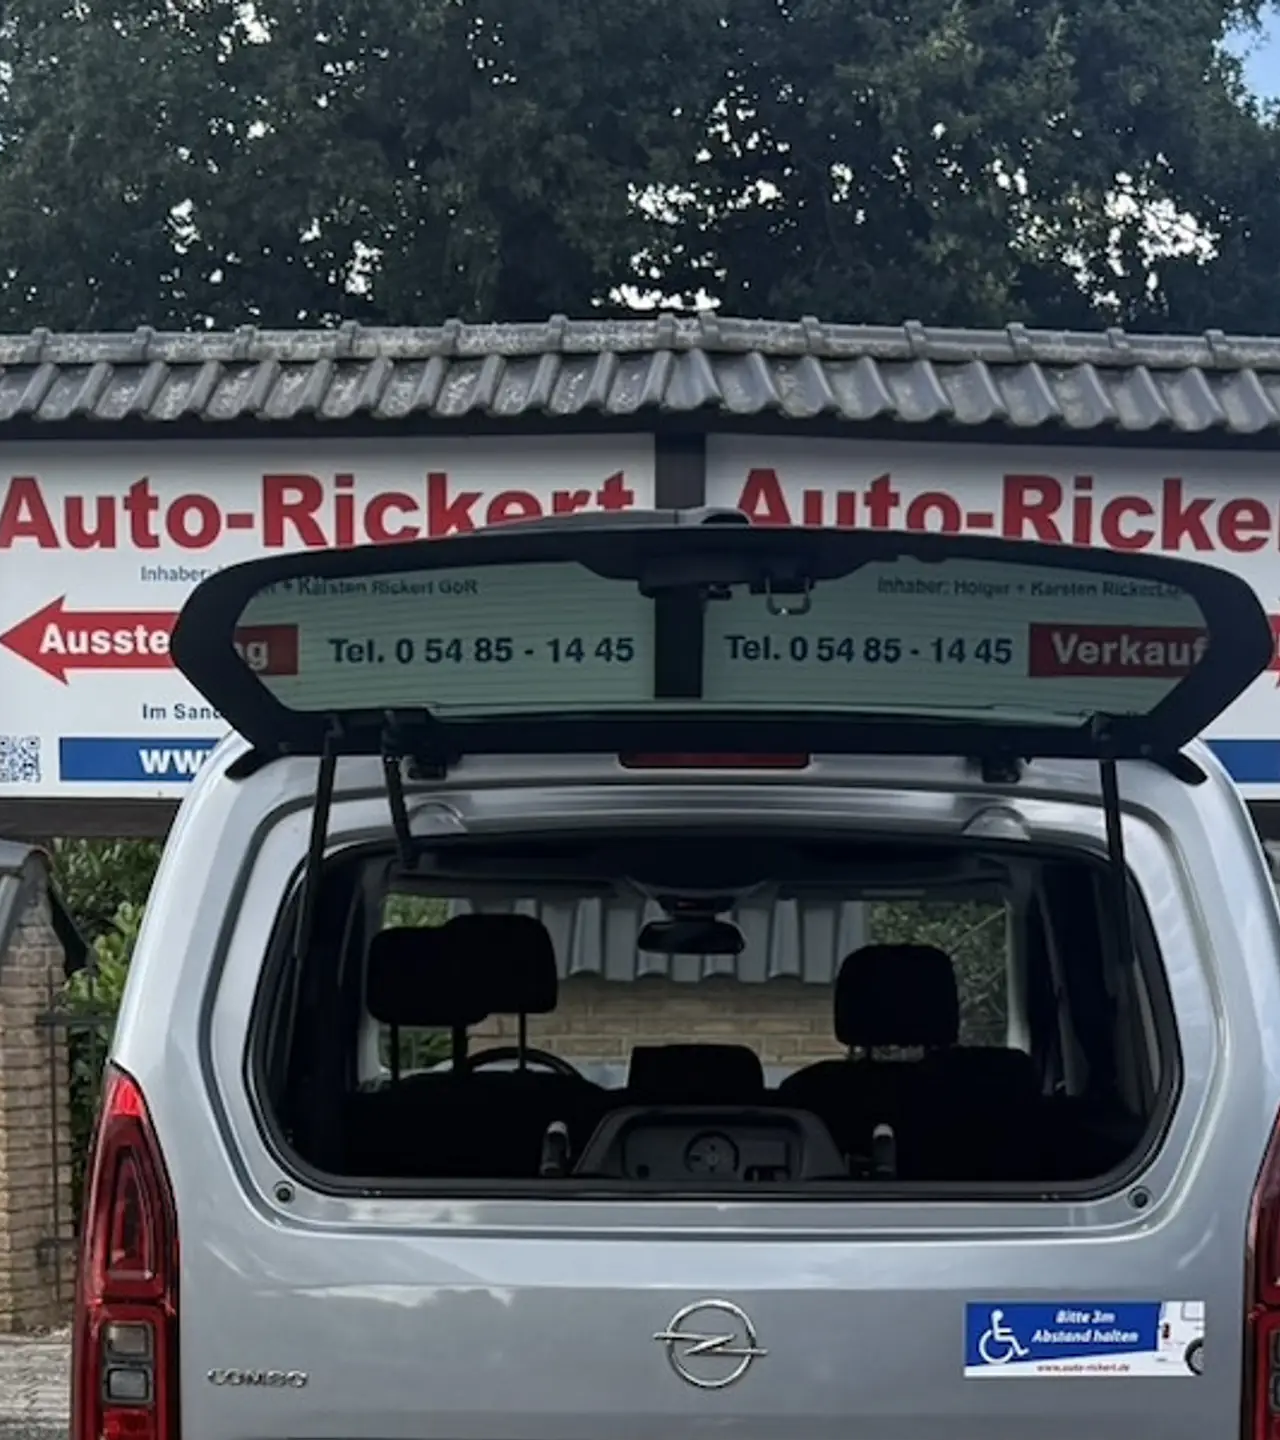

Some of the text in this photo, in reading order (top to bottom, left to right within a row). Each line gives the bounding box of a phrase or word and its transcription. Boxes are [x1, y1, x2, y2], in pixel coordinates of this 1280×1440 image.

[954, 578, 1009, 598] Holger
[1031, 580, 1097, 598] Karsten
[328, 637, 384, 663] Tel.
[395, 637, 414, 664] 0
[425, 637, 464, 664] 54
[474, 636, 513, 663] 85
[546, 636, 585, 664] 14
[594, 636, 635, 663] 45
[723, 635, 781, 661] Tel.
[789, 636, 808, 662] 0
[816, 636, 855, 663] 54
[863, 636, 902, 664] 85
[930, 637, 966, 664] 14
[974, 637, 1014, 665] 45
[142, 703, 167, 719] Im
[1055, 1309, 1091, 1324] Bitte
[1031, 1328, 1139, 1343] Abstand halten
